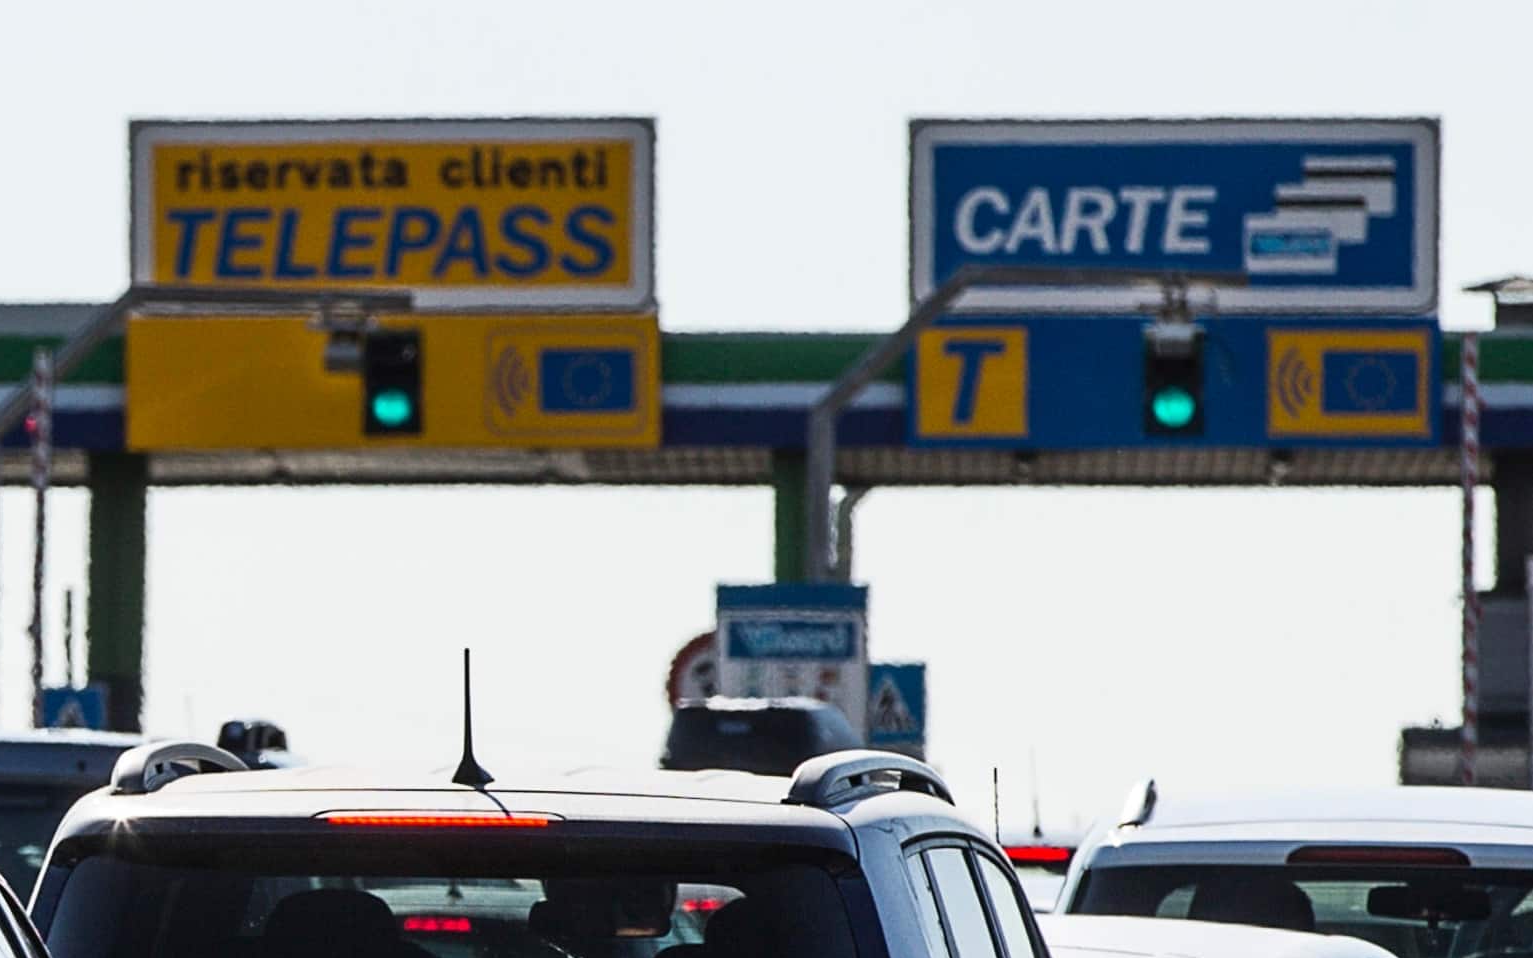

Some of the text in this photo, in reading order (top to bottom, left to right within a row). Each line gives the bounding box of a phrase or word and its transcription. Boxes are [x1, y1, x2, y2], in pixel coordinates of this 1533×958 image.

[175, 148, 608, 192] riservata clienti
[166, 204, 616, 280] TELEPASS
[954, 185, 1217, 255] CARTE
[941, 338, 1008, 427] T
